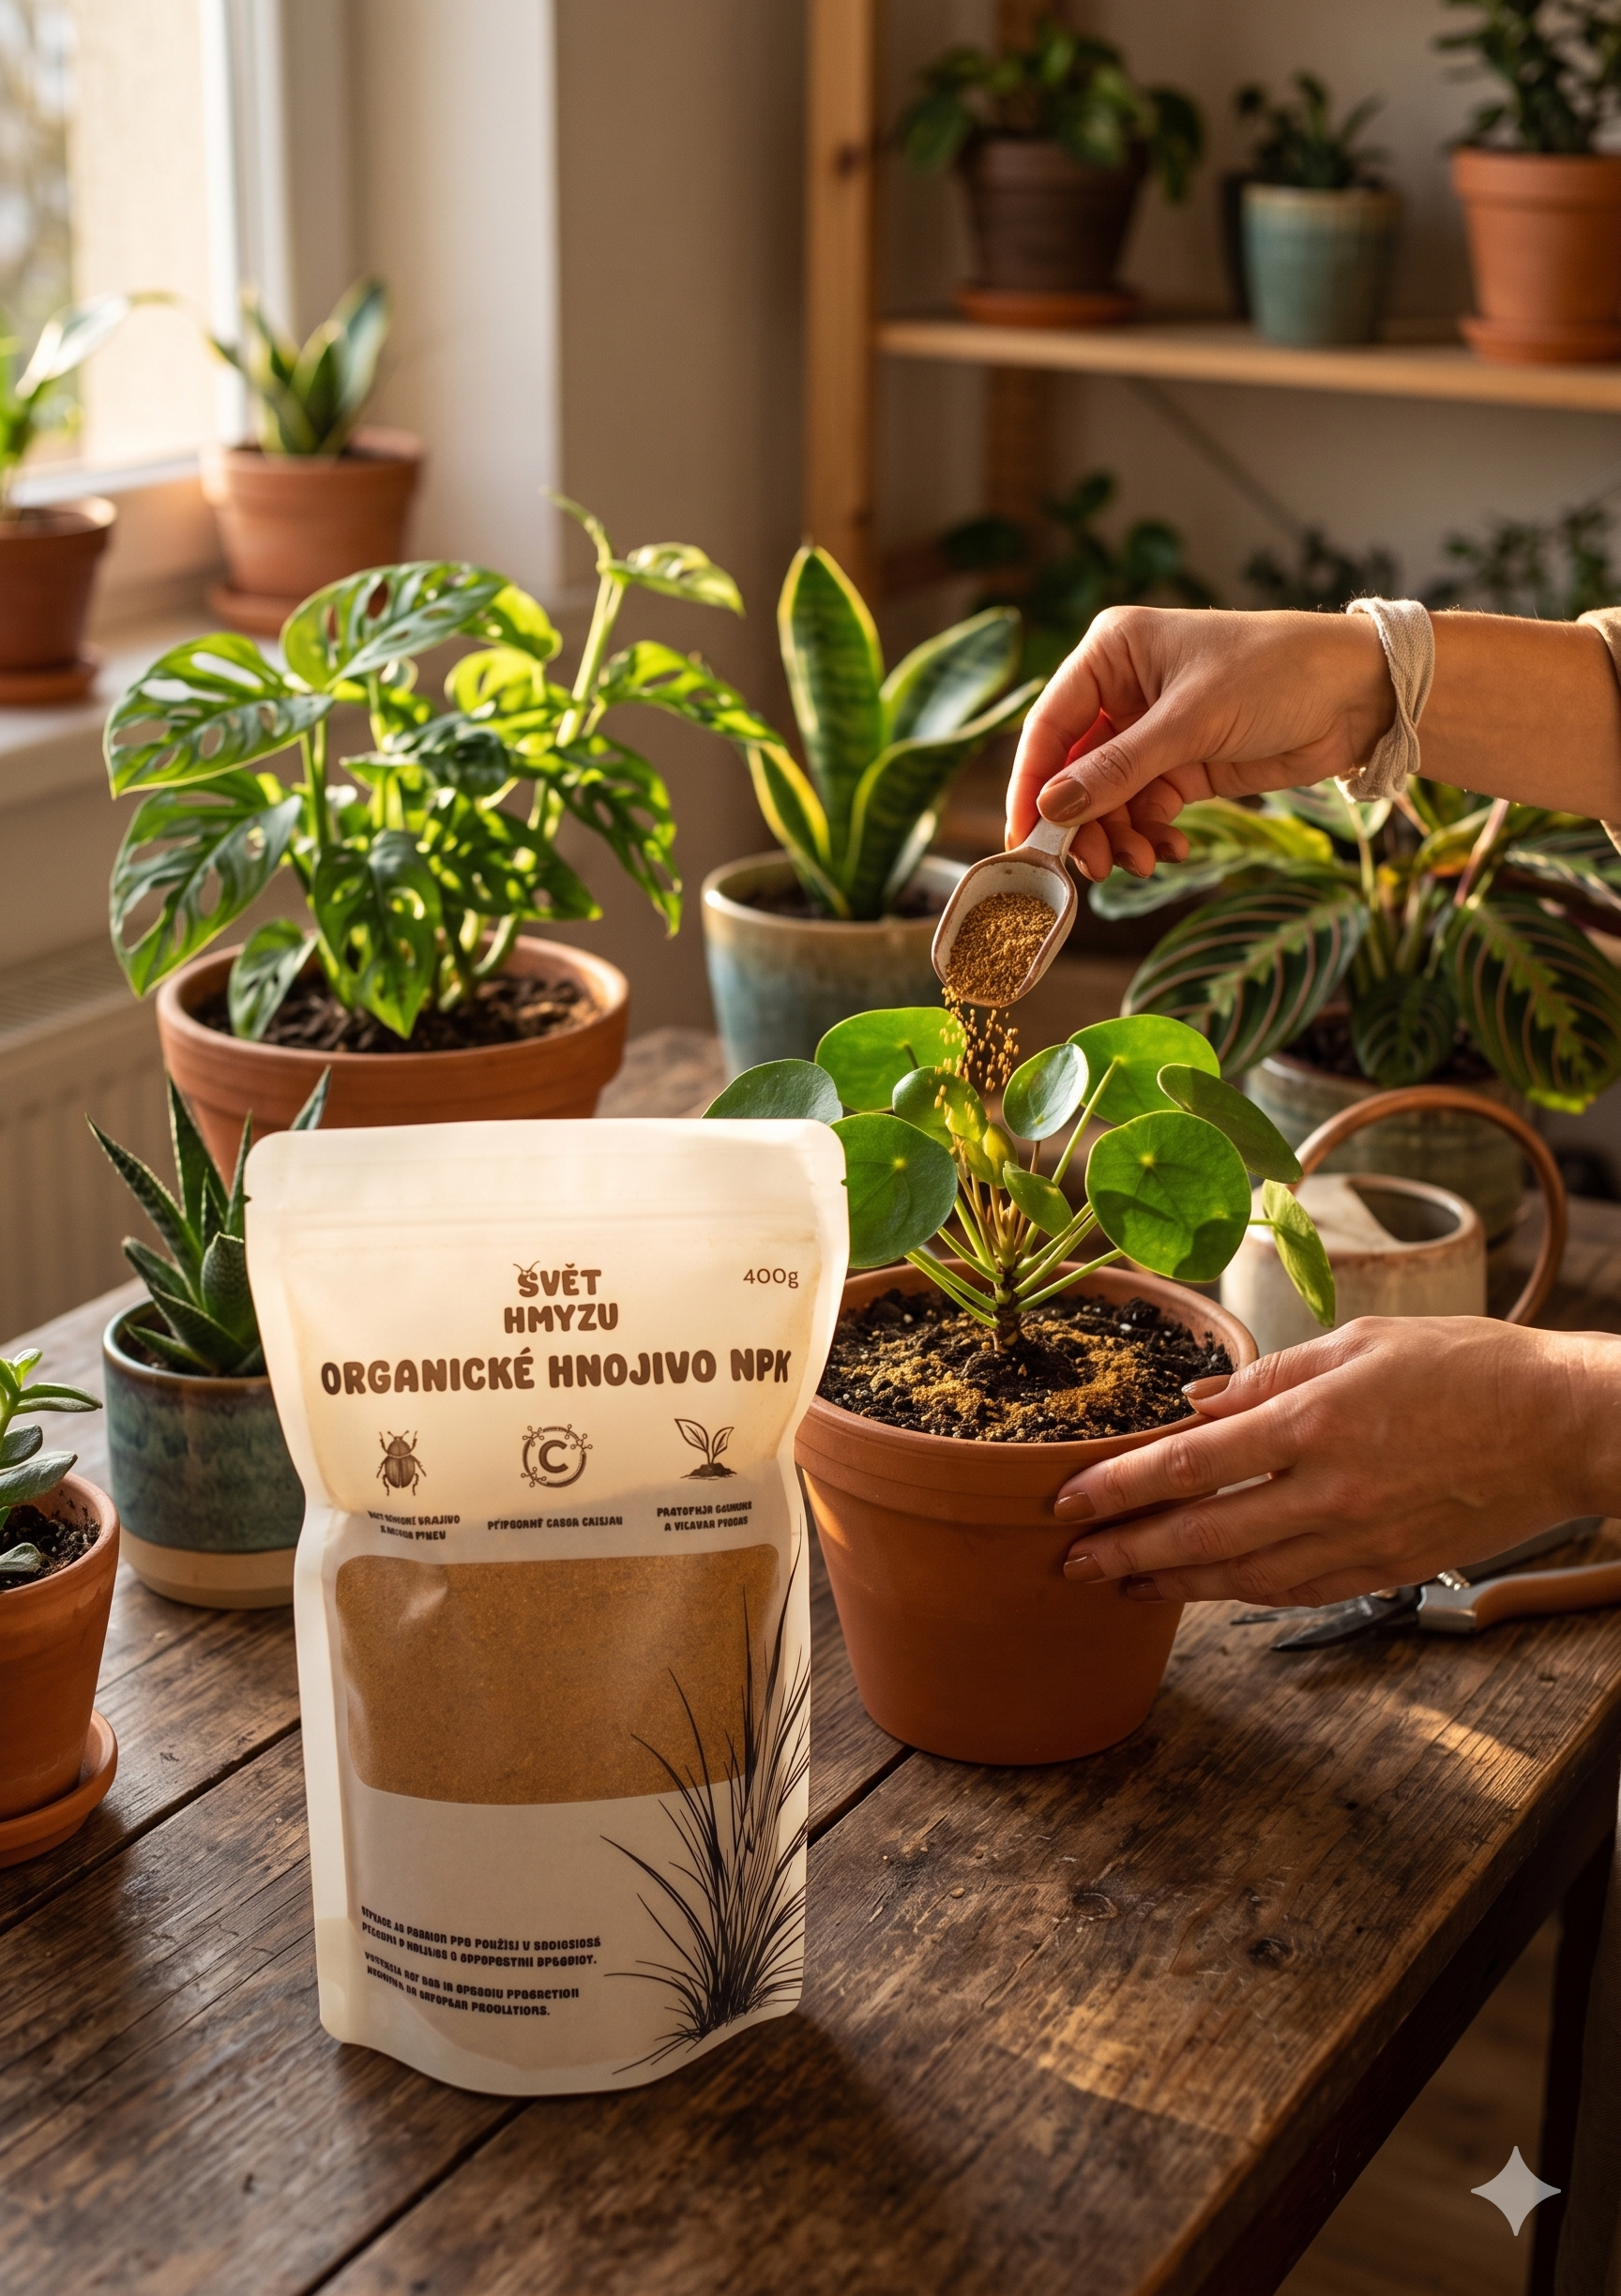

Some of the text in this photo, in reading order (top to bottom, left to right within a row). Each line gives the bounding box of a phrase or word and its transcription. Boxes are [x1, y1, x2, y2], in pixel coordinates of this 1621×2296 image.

[743, 1268, 798, 1289] 400g
[504, 1303, 618, 1334] HMYZU
[321, 1346, 792, 1395] ORGANICKÉ HNOJIVO NPK
